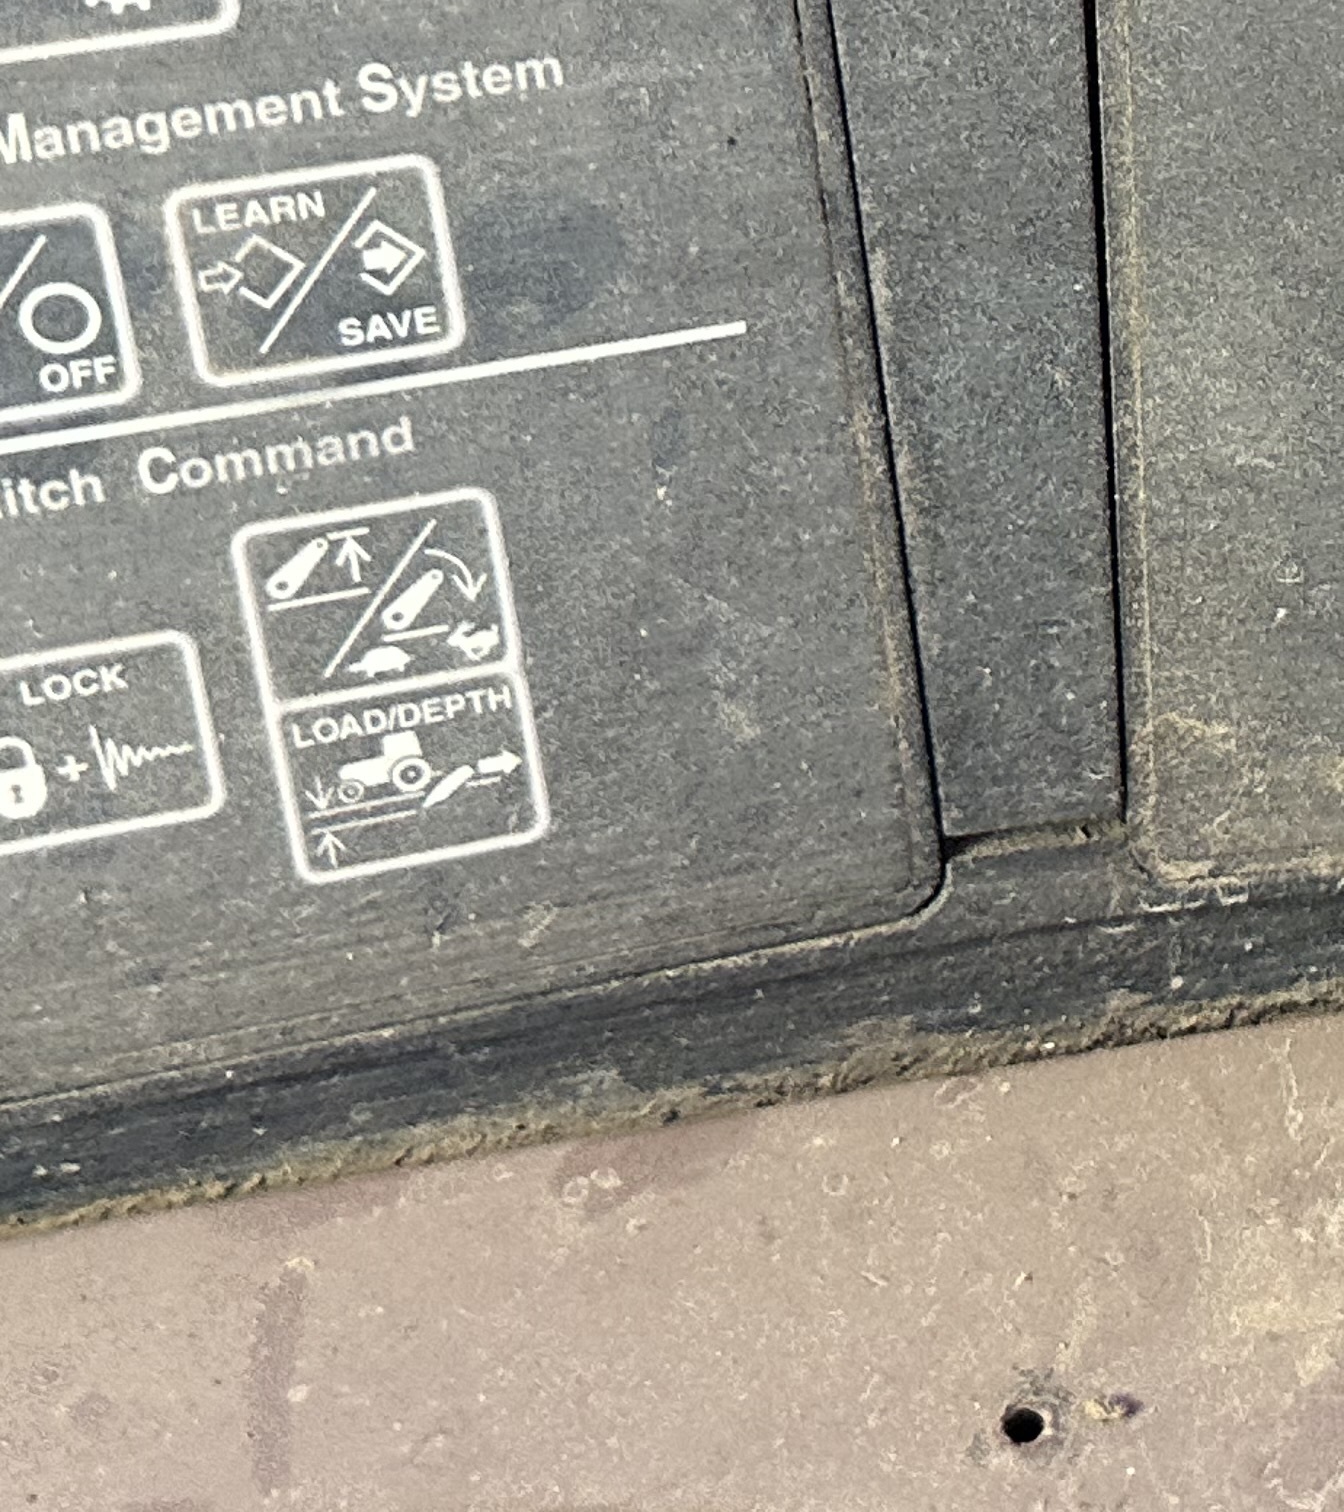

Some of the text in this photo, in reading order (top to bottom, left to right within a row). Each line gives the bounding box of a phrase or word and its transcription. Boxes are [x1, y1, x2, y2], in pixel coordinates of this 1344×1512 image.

[0, 55, 565, 165] Management System
[192, 191, 326, 235] LEARN
[337, 305, 442, 347] SAVE
[38, 355, 118, 393] OFF
[0, 416, 417, 520] itch Command
[20, 663, 130, 706] LOCK
[291, 686, 512, 748] LOAD/DEPTH
